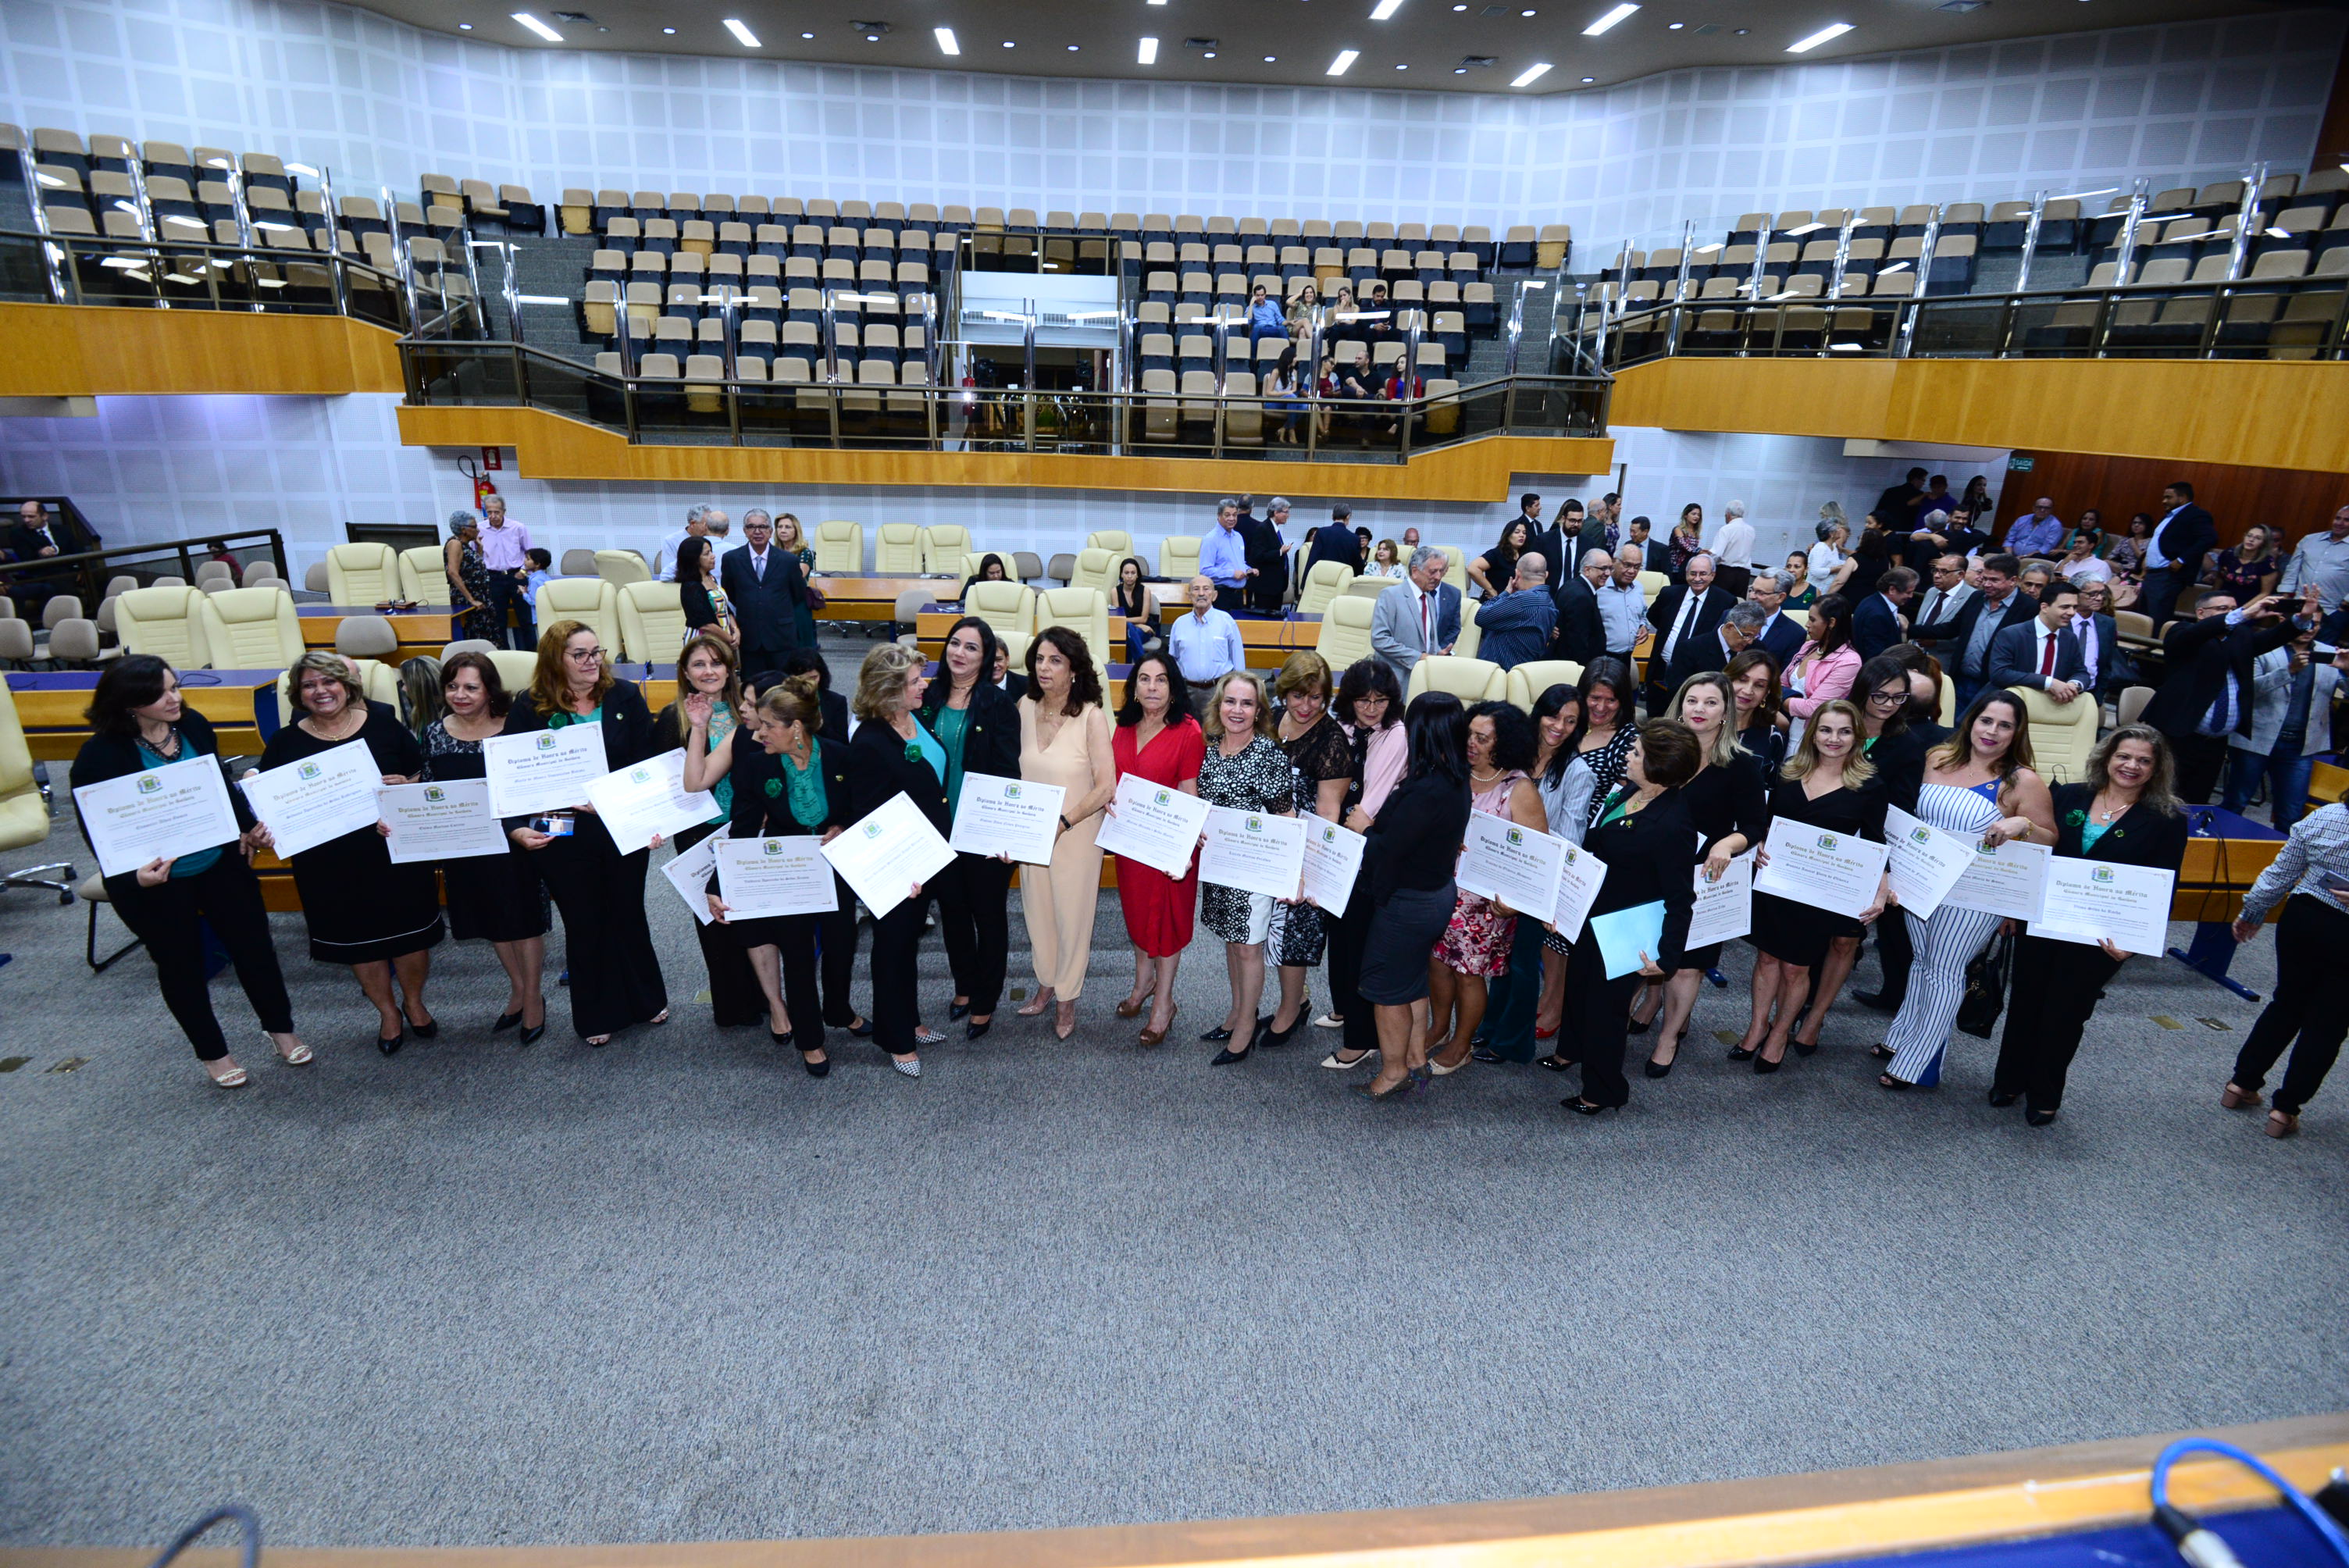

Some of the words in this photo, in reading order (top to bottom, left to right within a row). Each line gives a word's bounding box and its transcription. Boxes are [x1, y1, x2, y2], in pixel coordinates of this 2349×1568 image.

[1785, 842, 1807, 852] Diploma
[1844, 858, 1863, 867] Mérito
[2055, 880, 2081, 889] Diploma
